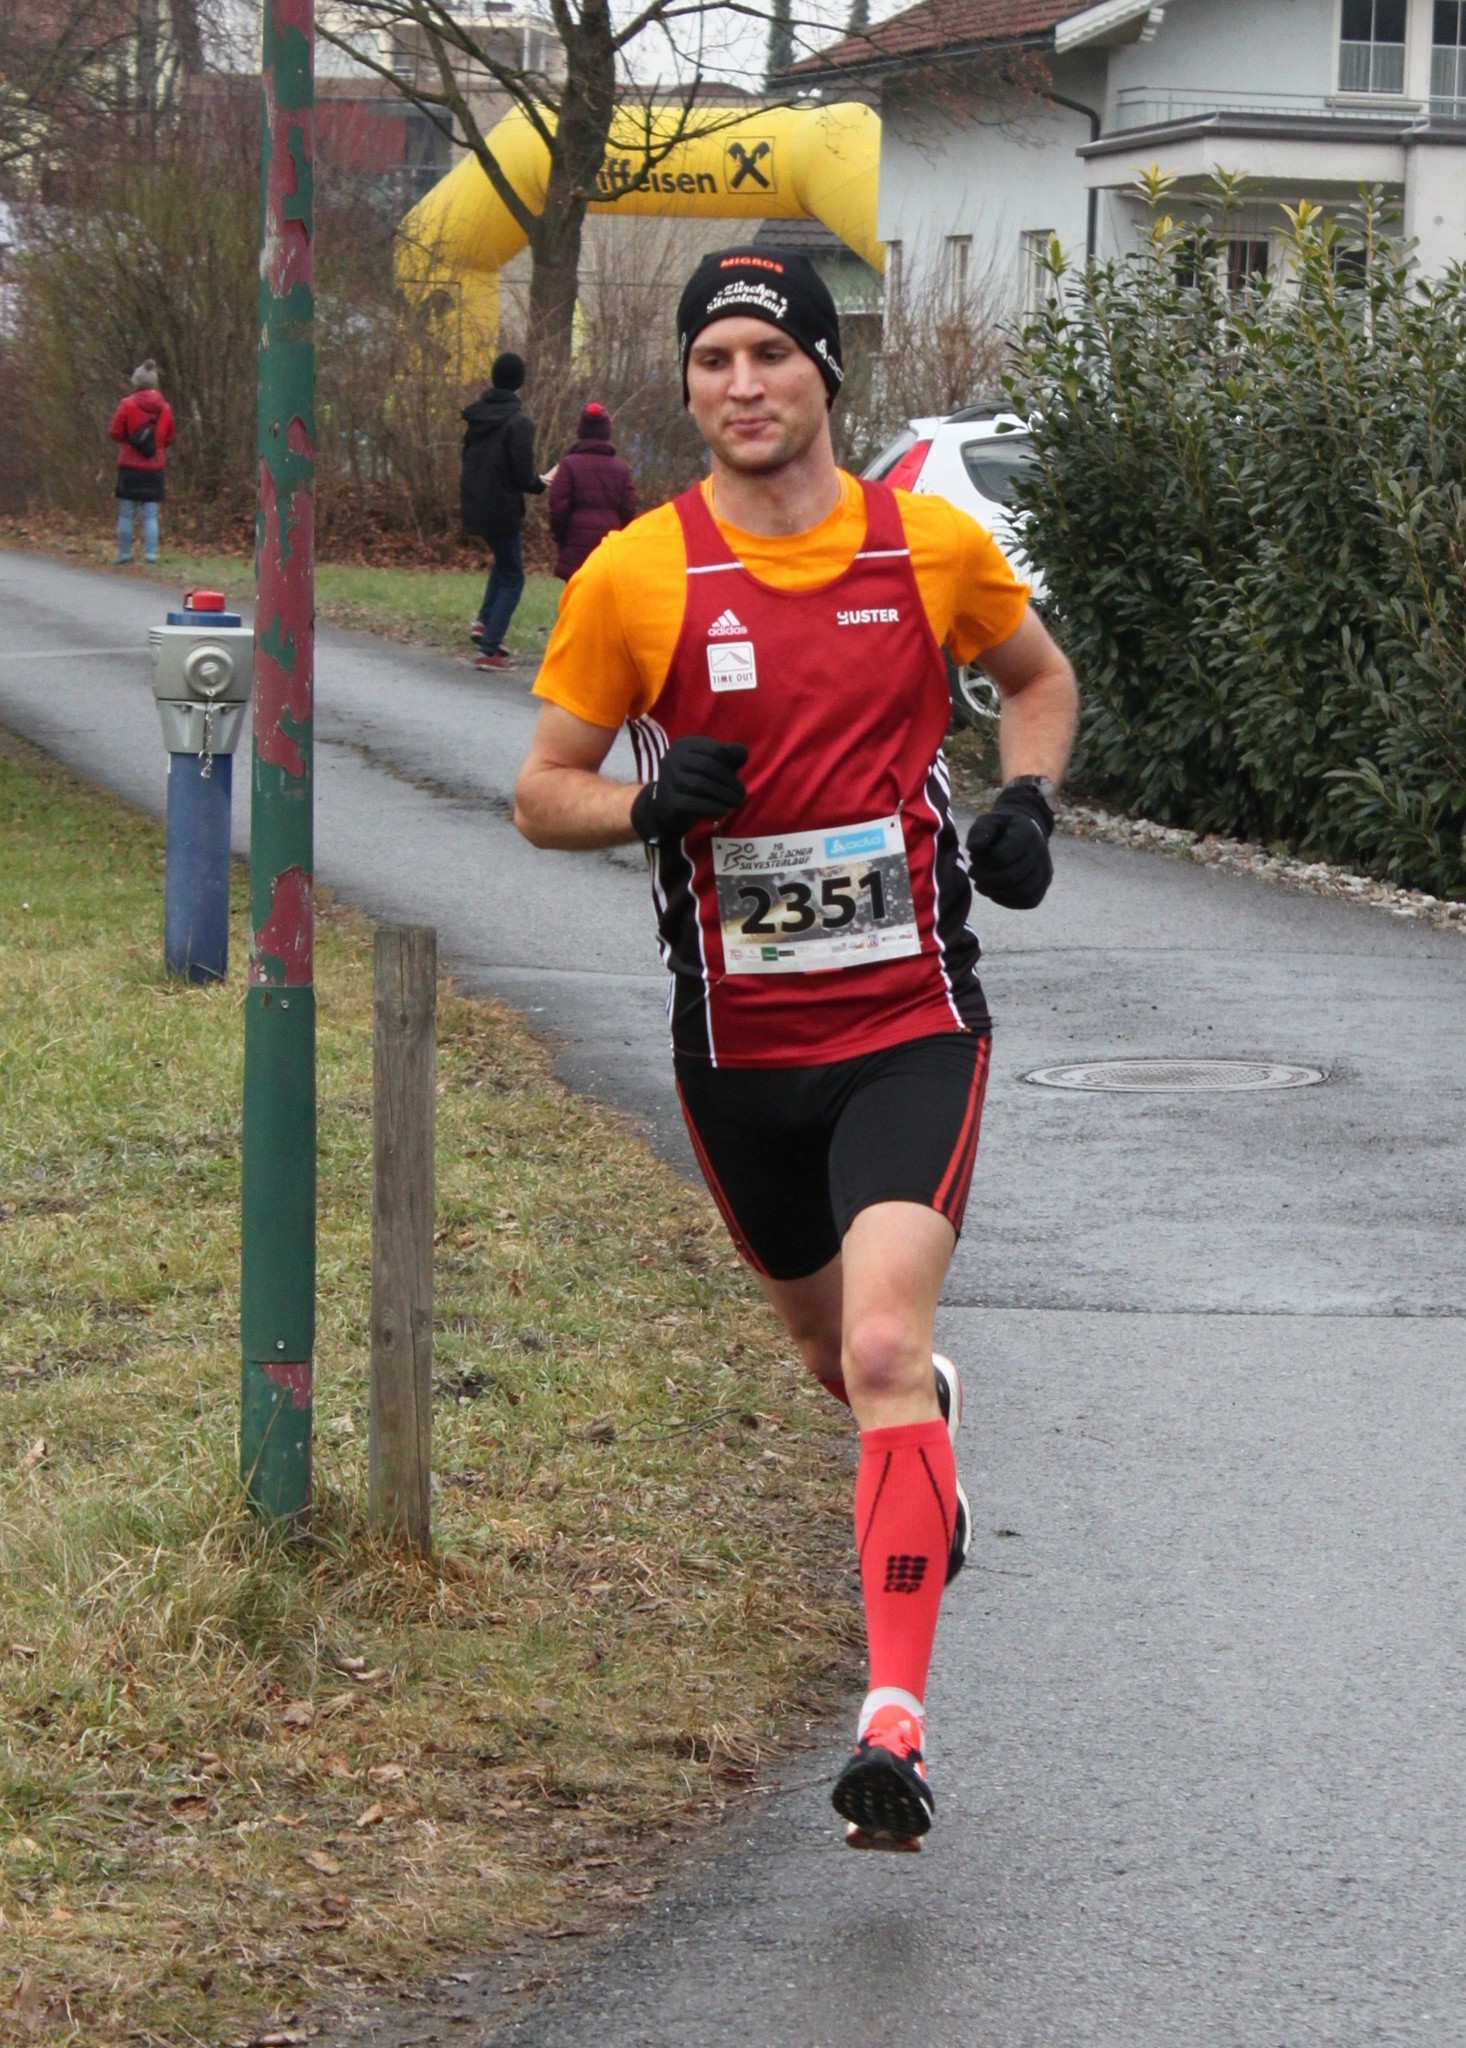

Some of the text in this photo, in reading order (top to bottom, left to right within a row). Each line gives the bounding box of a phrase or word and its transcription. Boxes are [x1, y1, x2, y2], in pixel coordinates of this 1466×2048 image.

[600, 158, 718, 194] iffeisen
[719, 255, 784, 274] MIGROS
[723, 280, 779, 301] Zürcher
[706, 293, 788, 319] Silvesterlauf
[707, 625, 748, 637] adidas
[712, 672, 754, 684] TIME OUT
[739, 856, 811, 870] SILVESTERLAUF
[737, 870, 886, 935] 2351
[883, 1581, 921, 1595] cep
